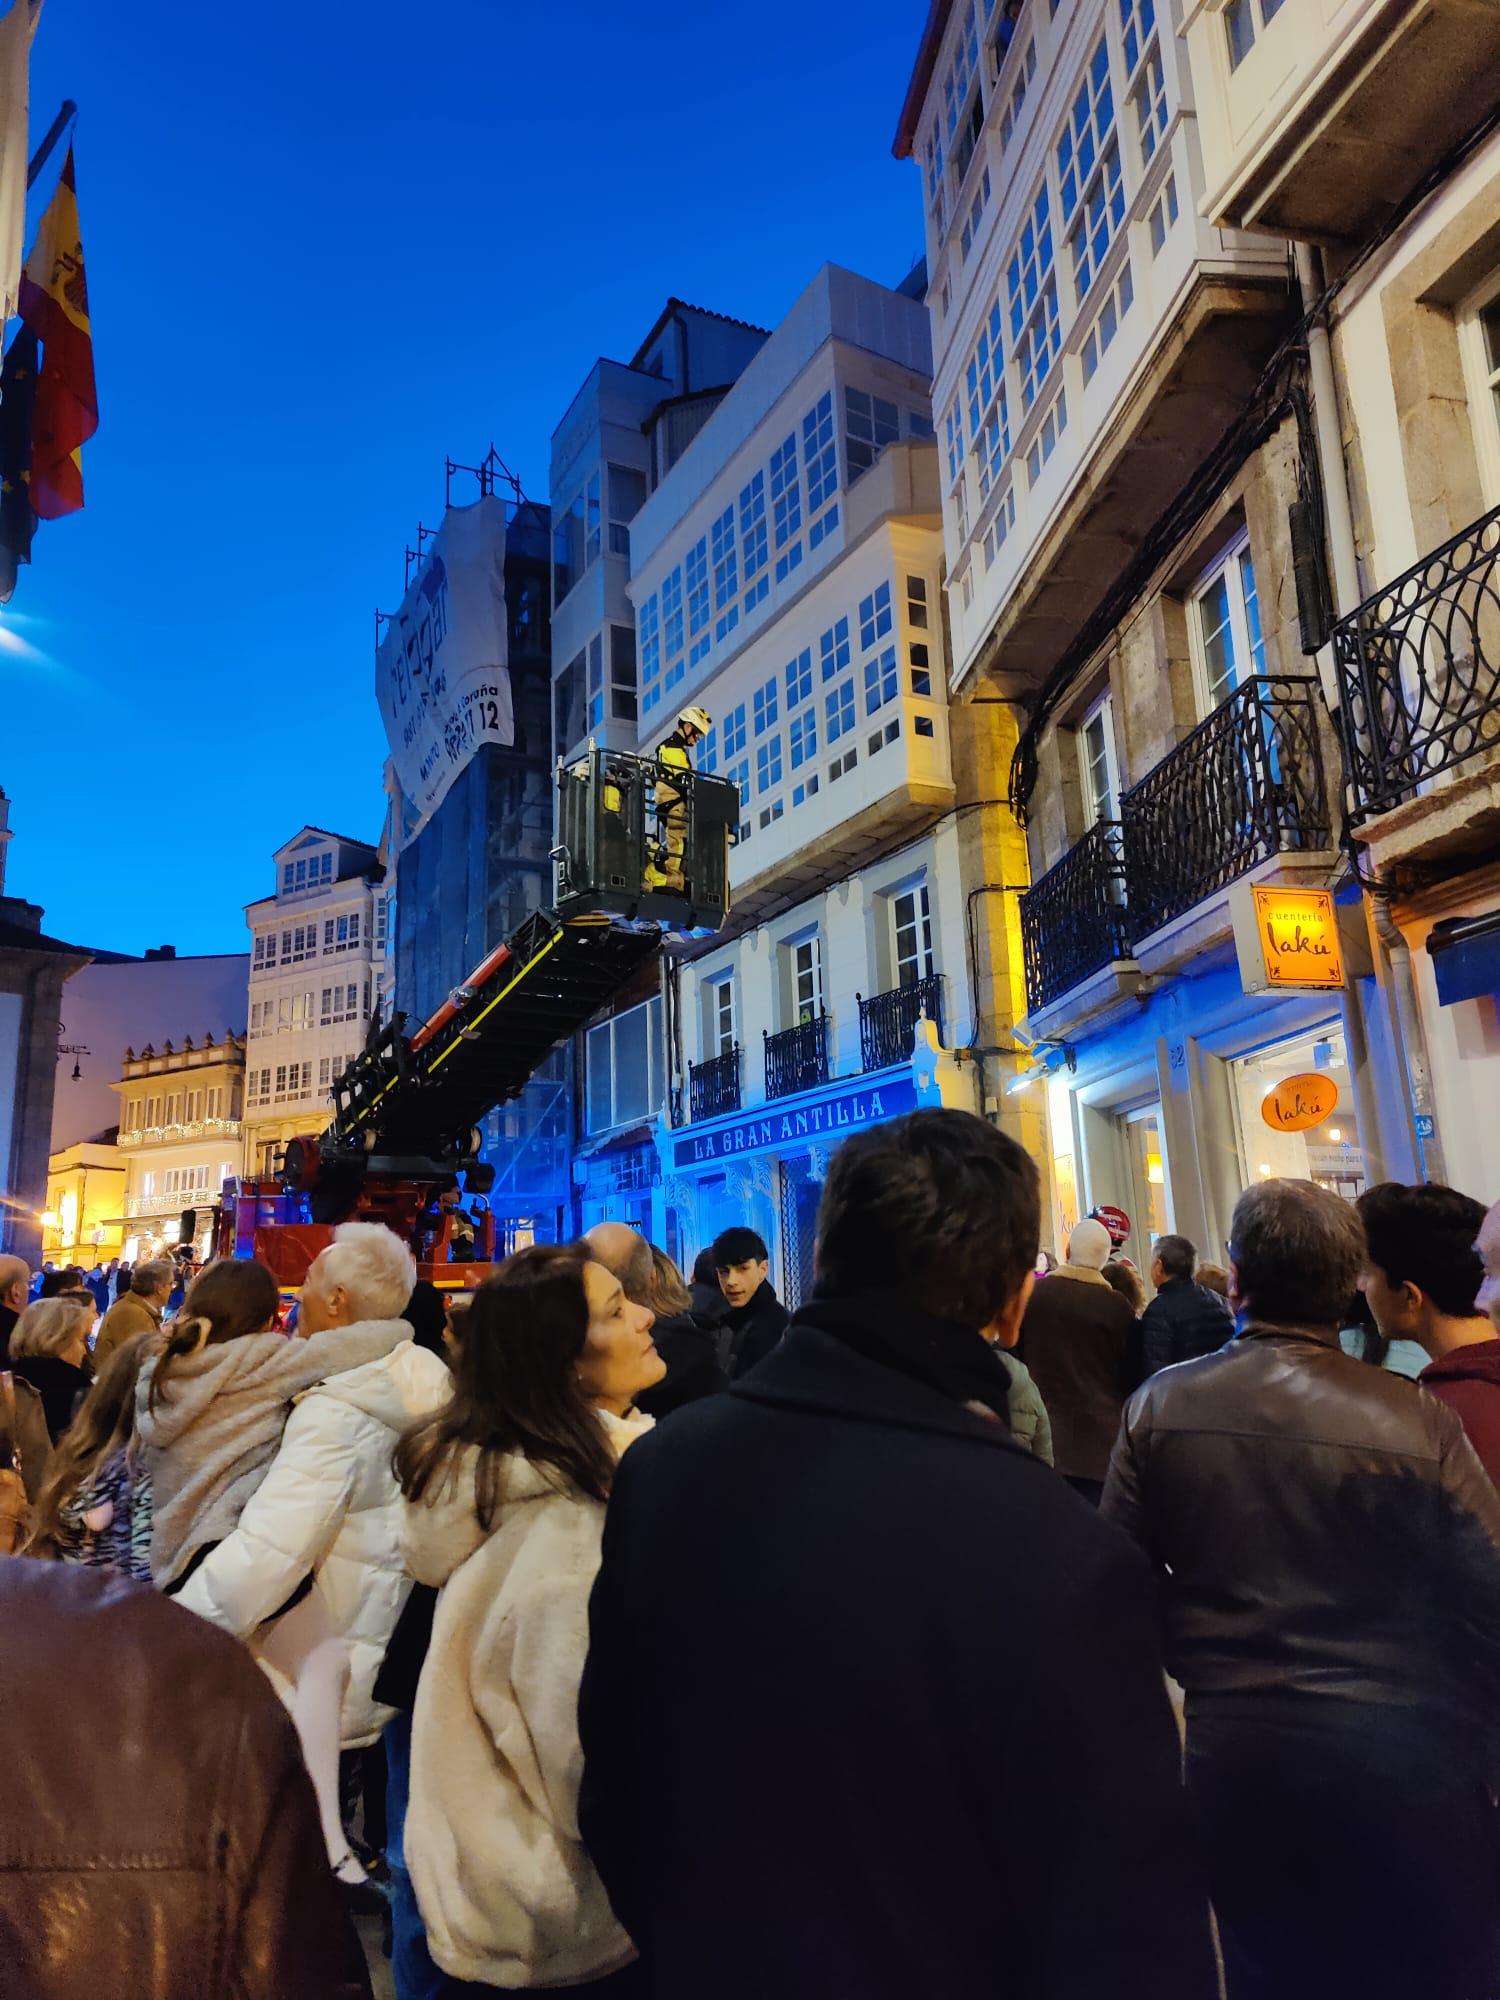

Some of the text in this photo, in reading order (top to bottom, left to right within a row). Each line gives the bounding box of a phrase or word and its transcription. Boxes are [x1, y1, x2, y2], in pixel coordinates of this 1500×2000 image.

[1267, 922, 1331, 957] lakú
[694, 1092, 884, 1160] LA GRAN ANTILLA
[1275, 1094, 1323, 1126] lakú
